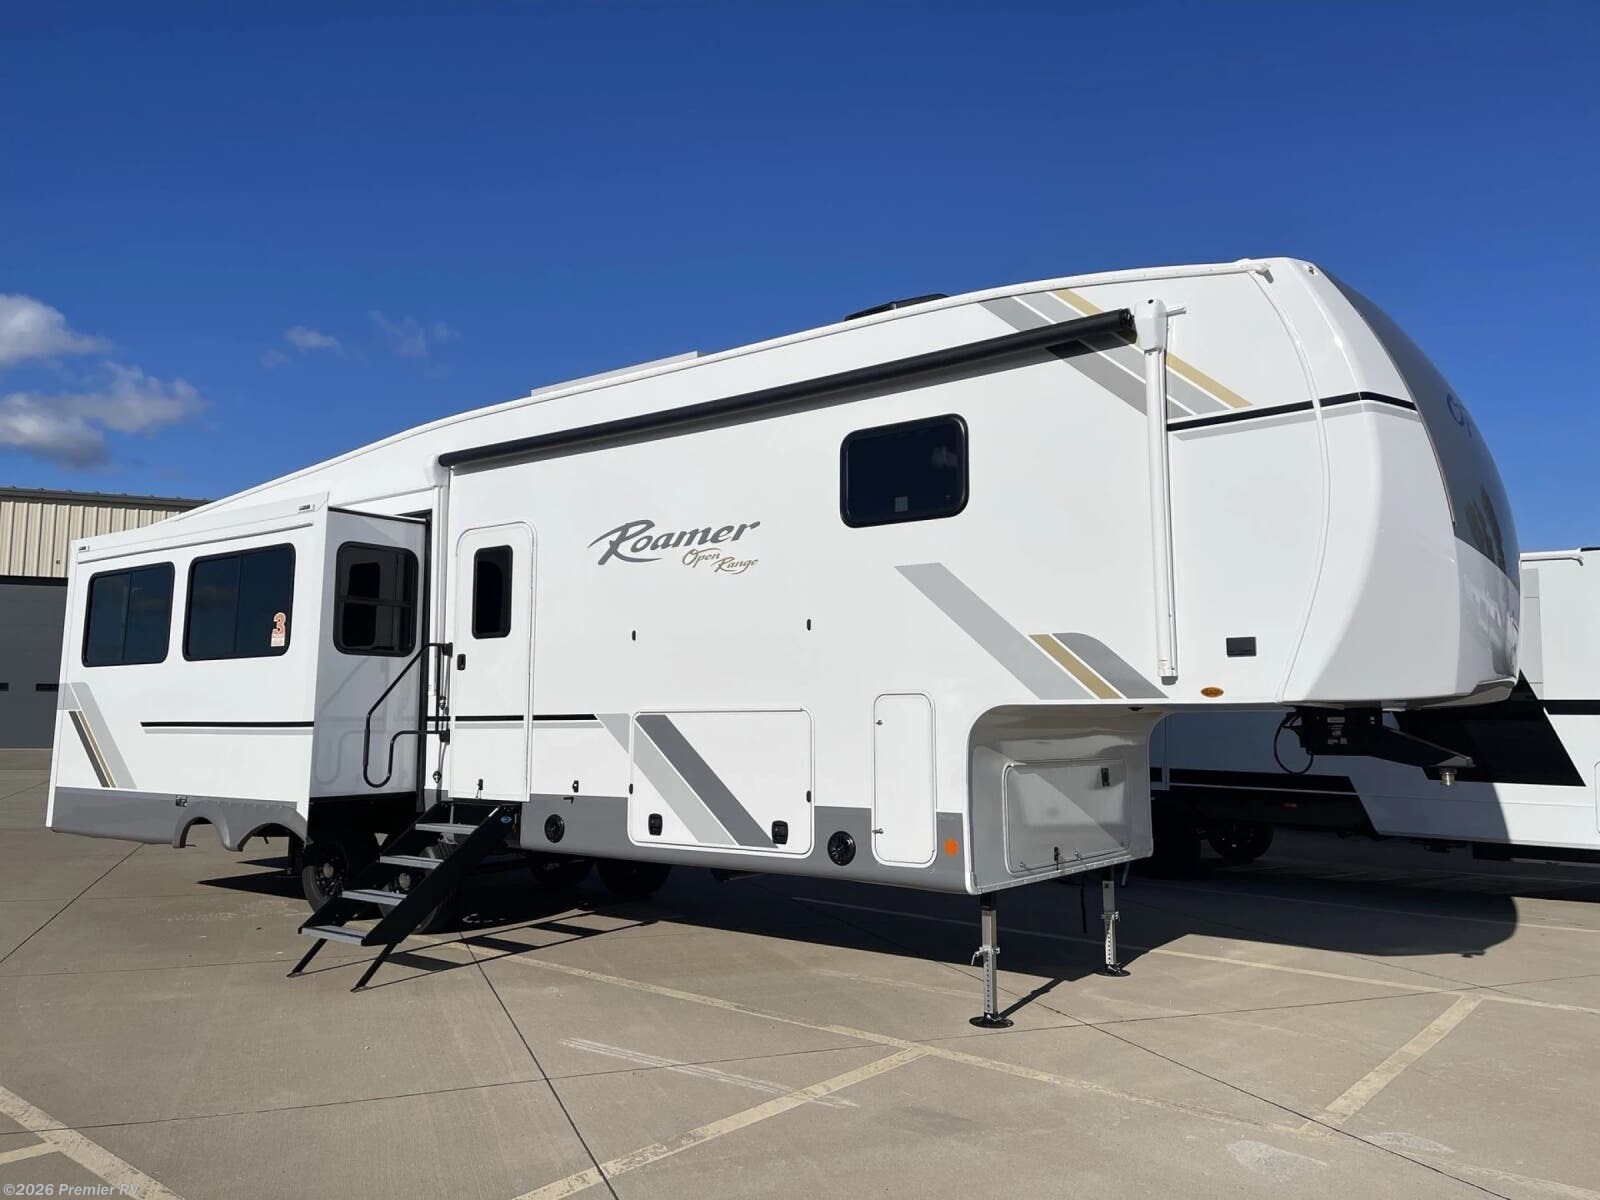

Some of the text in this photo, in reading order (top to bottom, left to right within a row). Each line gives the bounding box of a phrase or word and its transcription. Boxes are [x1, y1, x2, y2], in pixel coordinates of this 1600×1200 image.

[587, 519, 761, 566] Roamer
[682, 547, 759, 575] Open Range
[273, 612, 286, 635] 3
